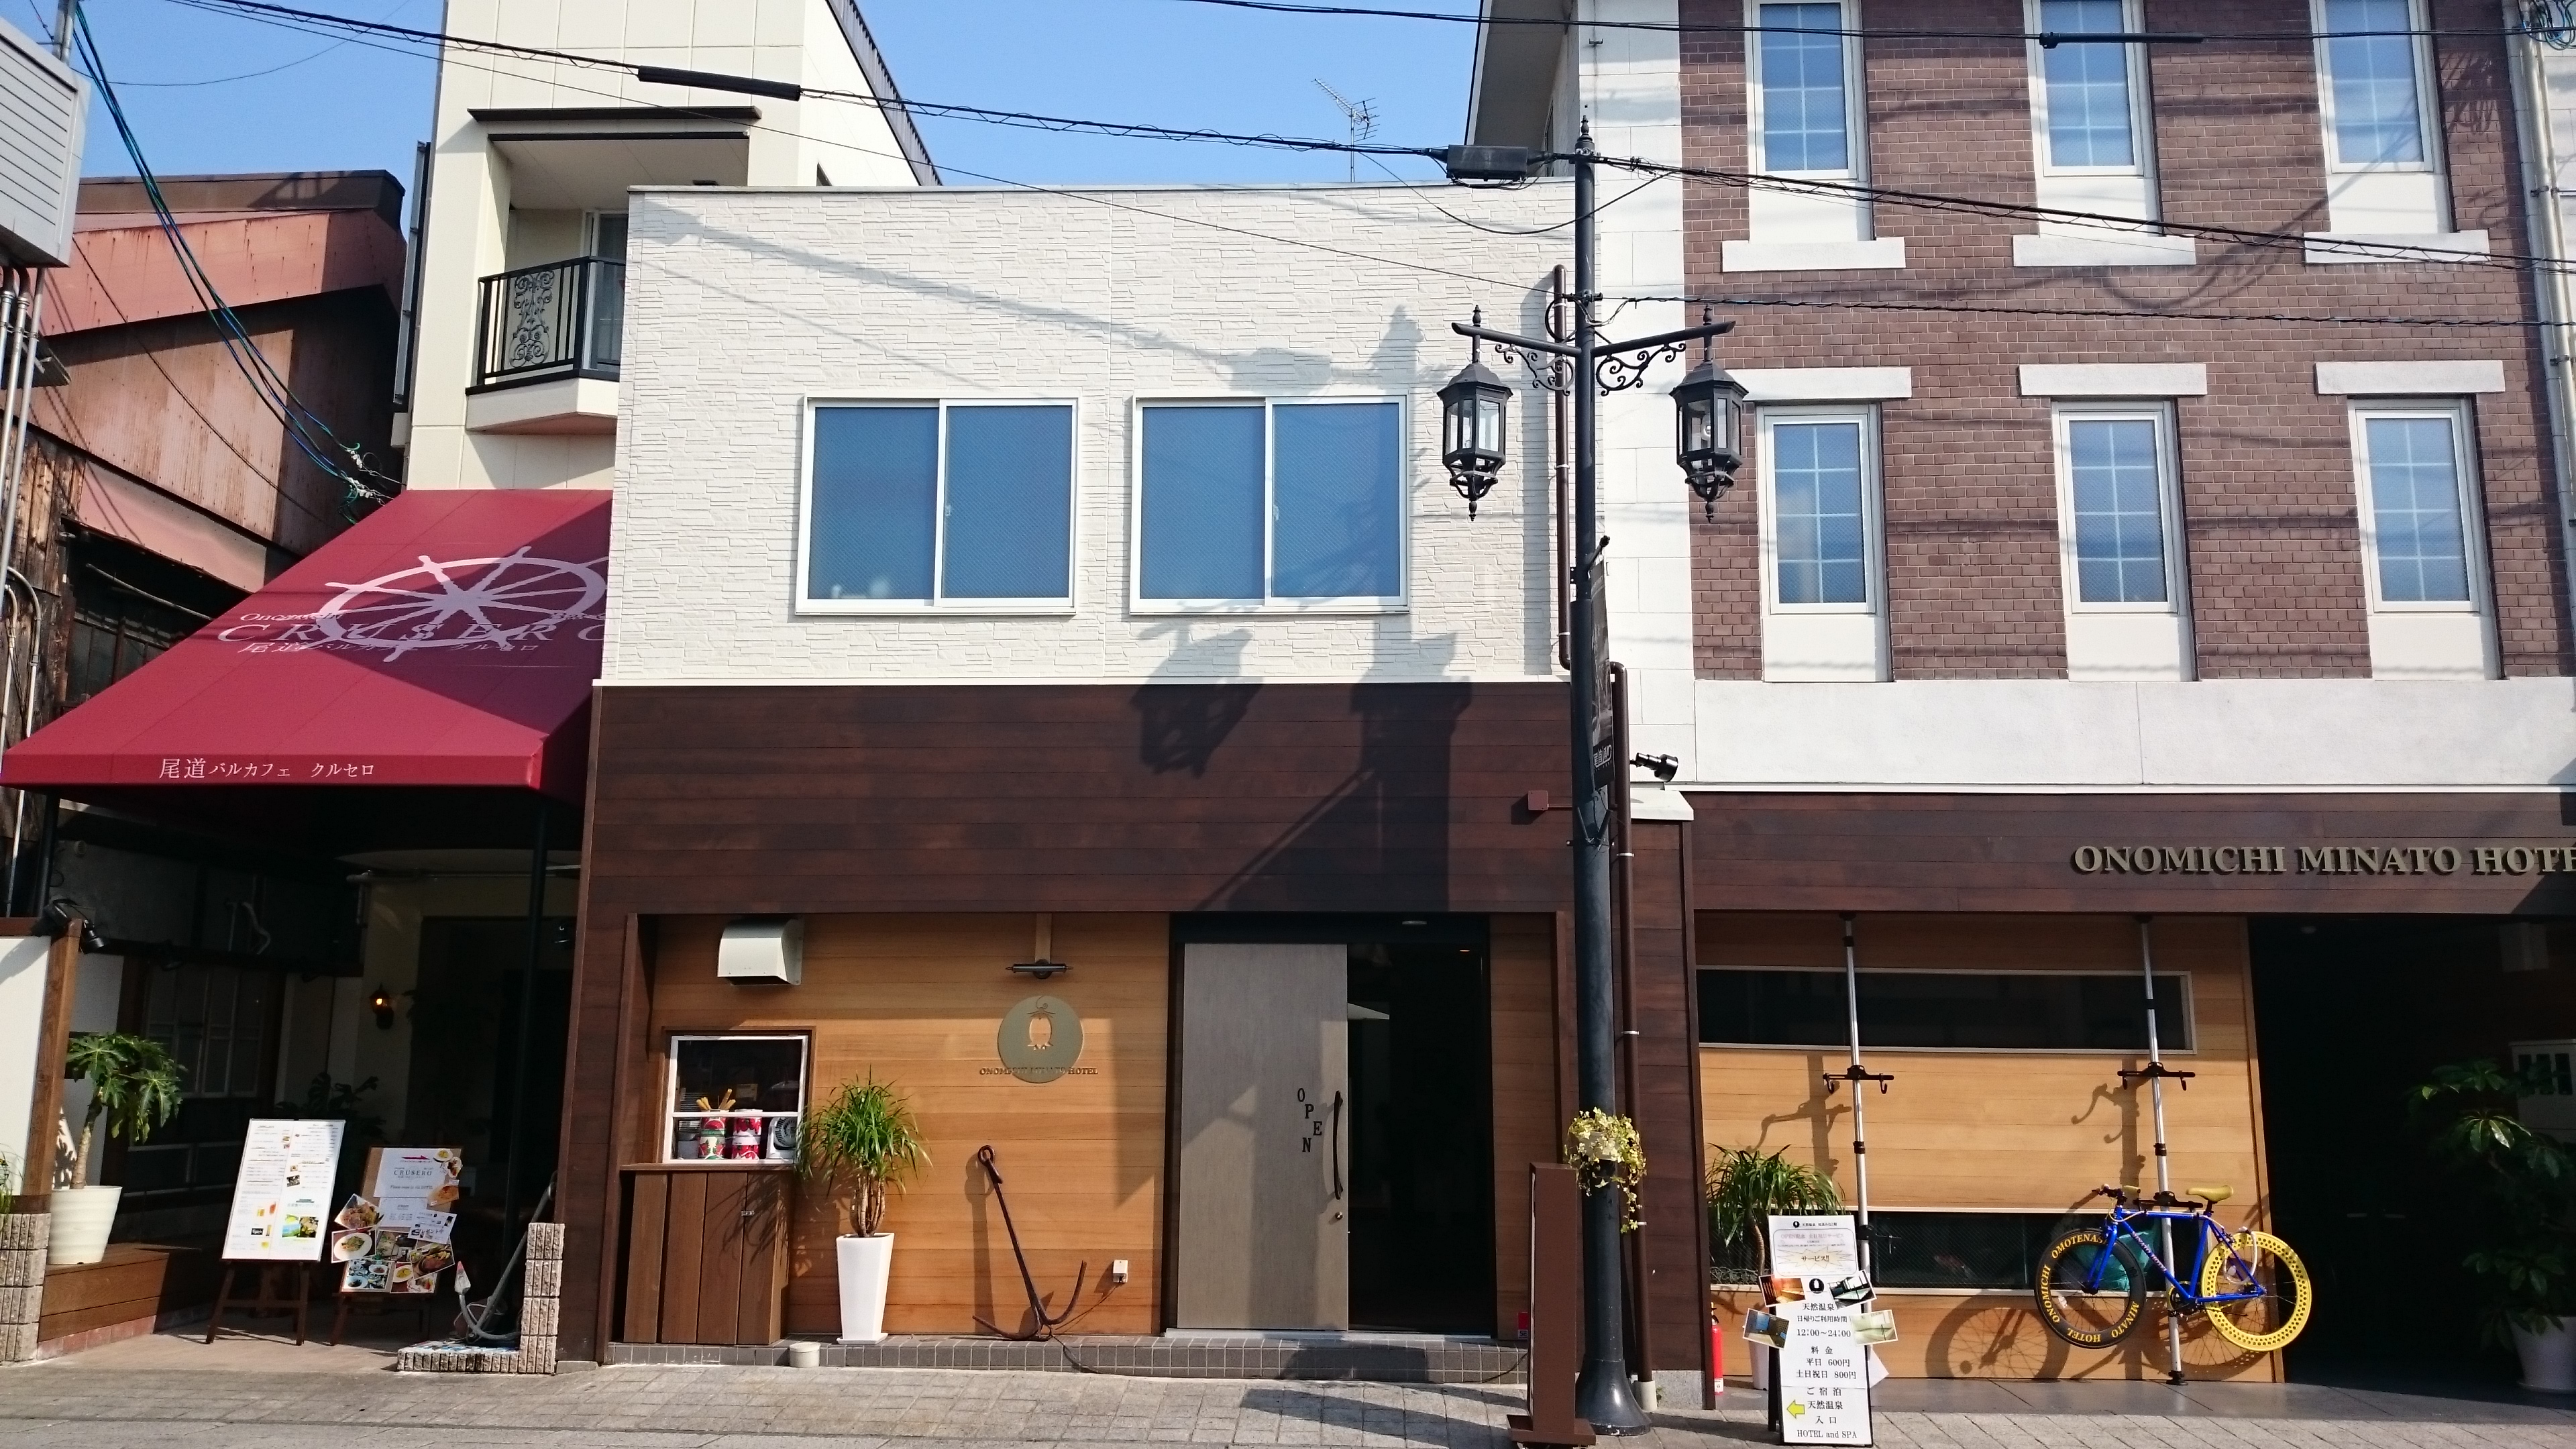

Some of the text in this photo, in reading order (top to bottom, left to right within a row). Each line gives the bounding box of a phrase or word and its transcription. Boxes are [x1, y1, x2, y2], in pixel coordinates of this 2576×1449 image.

[159, 757, 374, 780] 尾道バルカフェ クルセロ
[2074, 846, 2287, 871] ONOMICHI
[2298, 847, 2461, 872] MINATO
[2051, 1234, 2107, 1259] OMOTENAS
[2041, 1265, 2061, 1324] ONOMICHI
[1803, 1303, 1835, 1311] 天然温泉
[2111, 1301, 2140, 1338] MINATO
[2067, 1328, 2102, 1343] HOTEL
[1807, 1358, 1850, 1367] 平日 600円
[1796, 1370, 1856, 1379] 土日祝日 800円
[1807, 1401, 1843, 1409] 天然温泉
[1797, 1430, 1823, 1438] HOTEL
